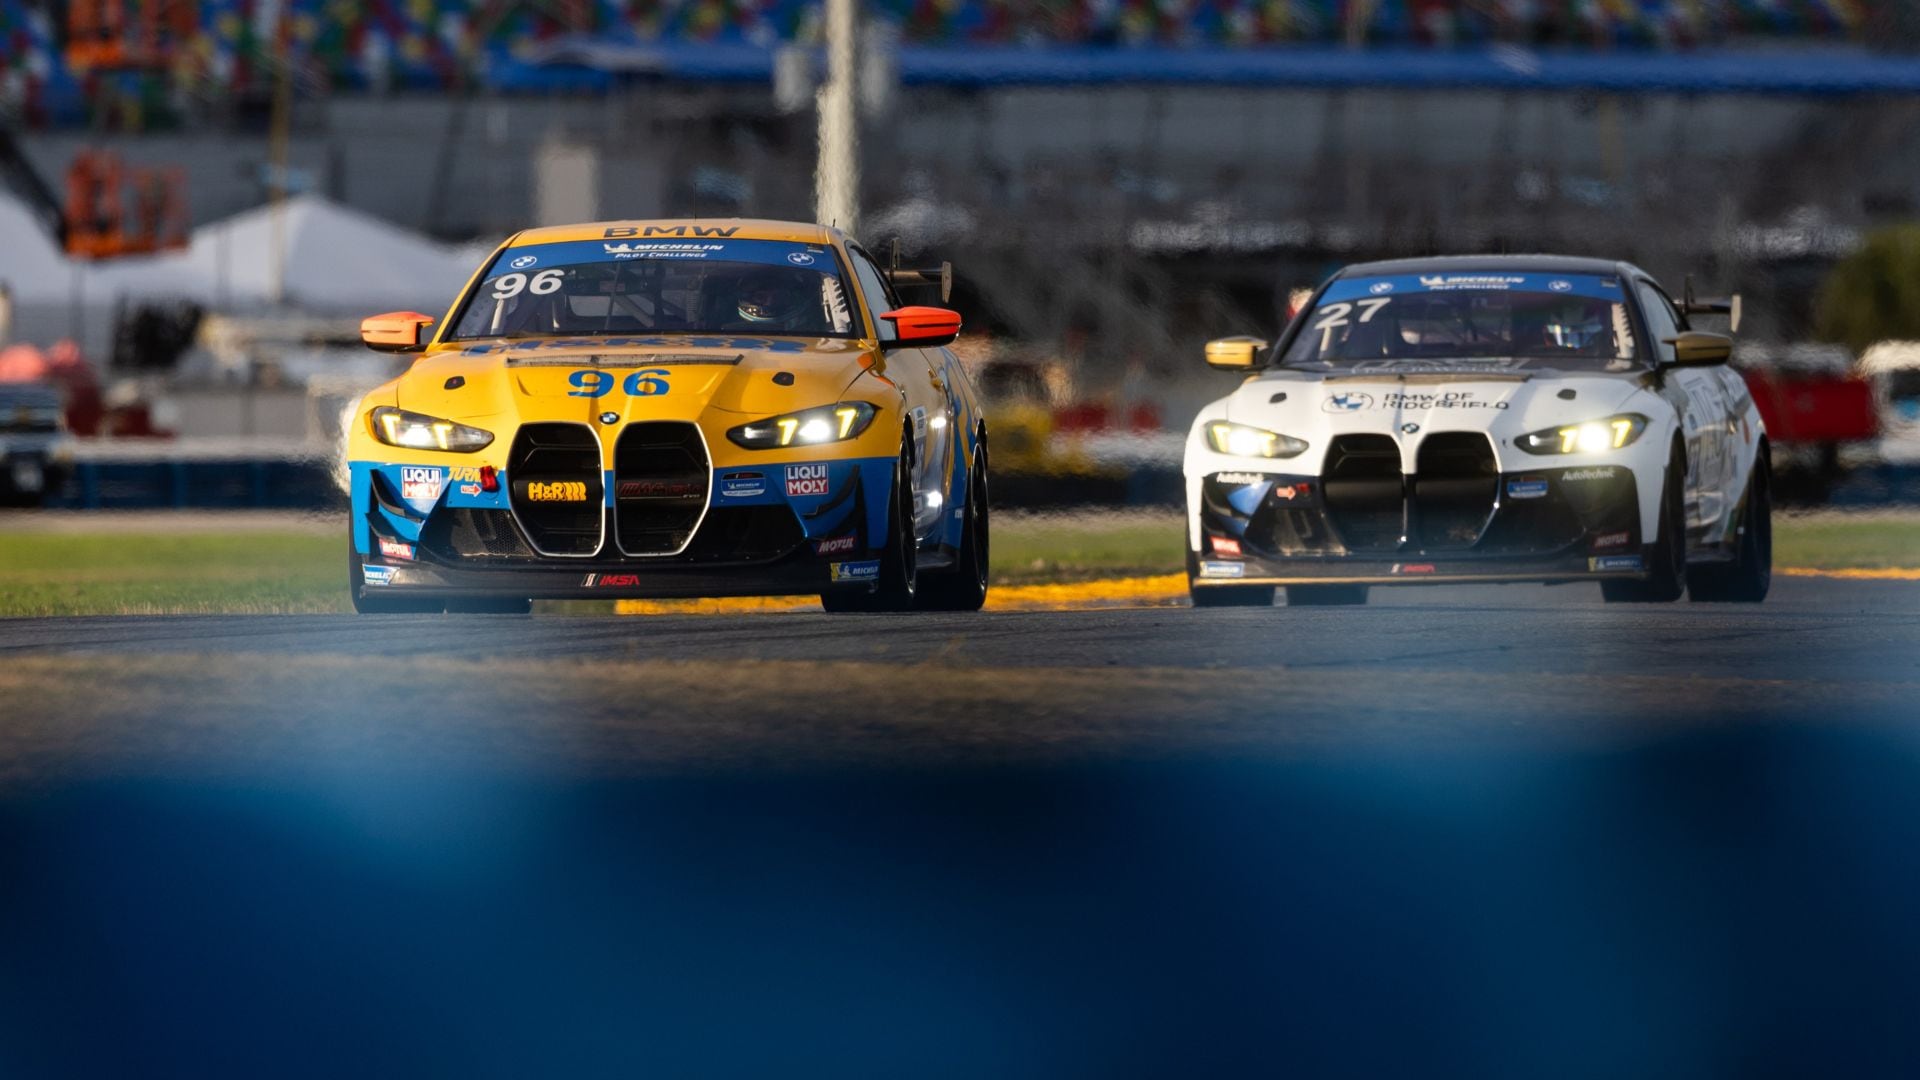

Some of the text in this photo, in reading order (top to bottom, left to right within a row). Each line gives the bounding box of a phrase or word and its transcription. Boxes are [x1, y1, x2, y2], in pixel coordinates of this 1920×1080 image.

[604, 226, 740, 238] BMW
[491, 269, 566, 300] 96
[1315, 297, 1392, 331] 27
[567, 369, 671, 398] 96
[403, 468, 440, 483] LIQUI
[448, 467, 499, 483] TURN
[787, 464, 827, 480] LIQUI
[788, 478, 828, 495] MOLY
[818, 537, 855, 553] MOTUL
[600, 575, 641, 586] IMSA
